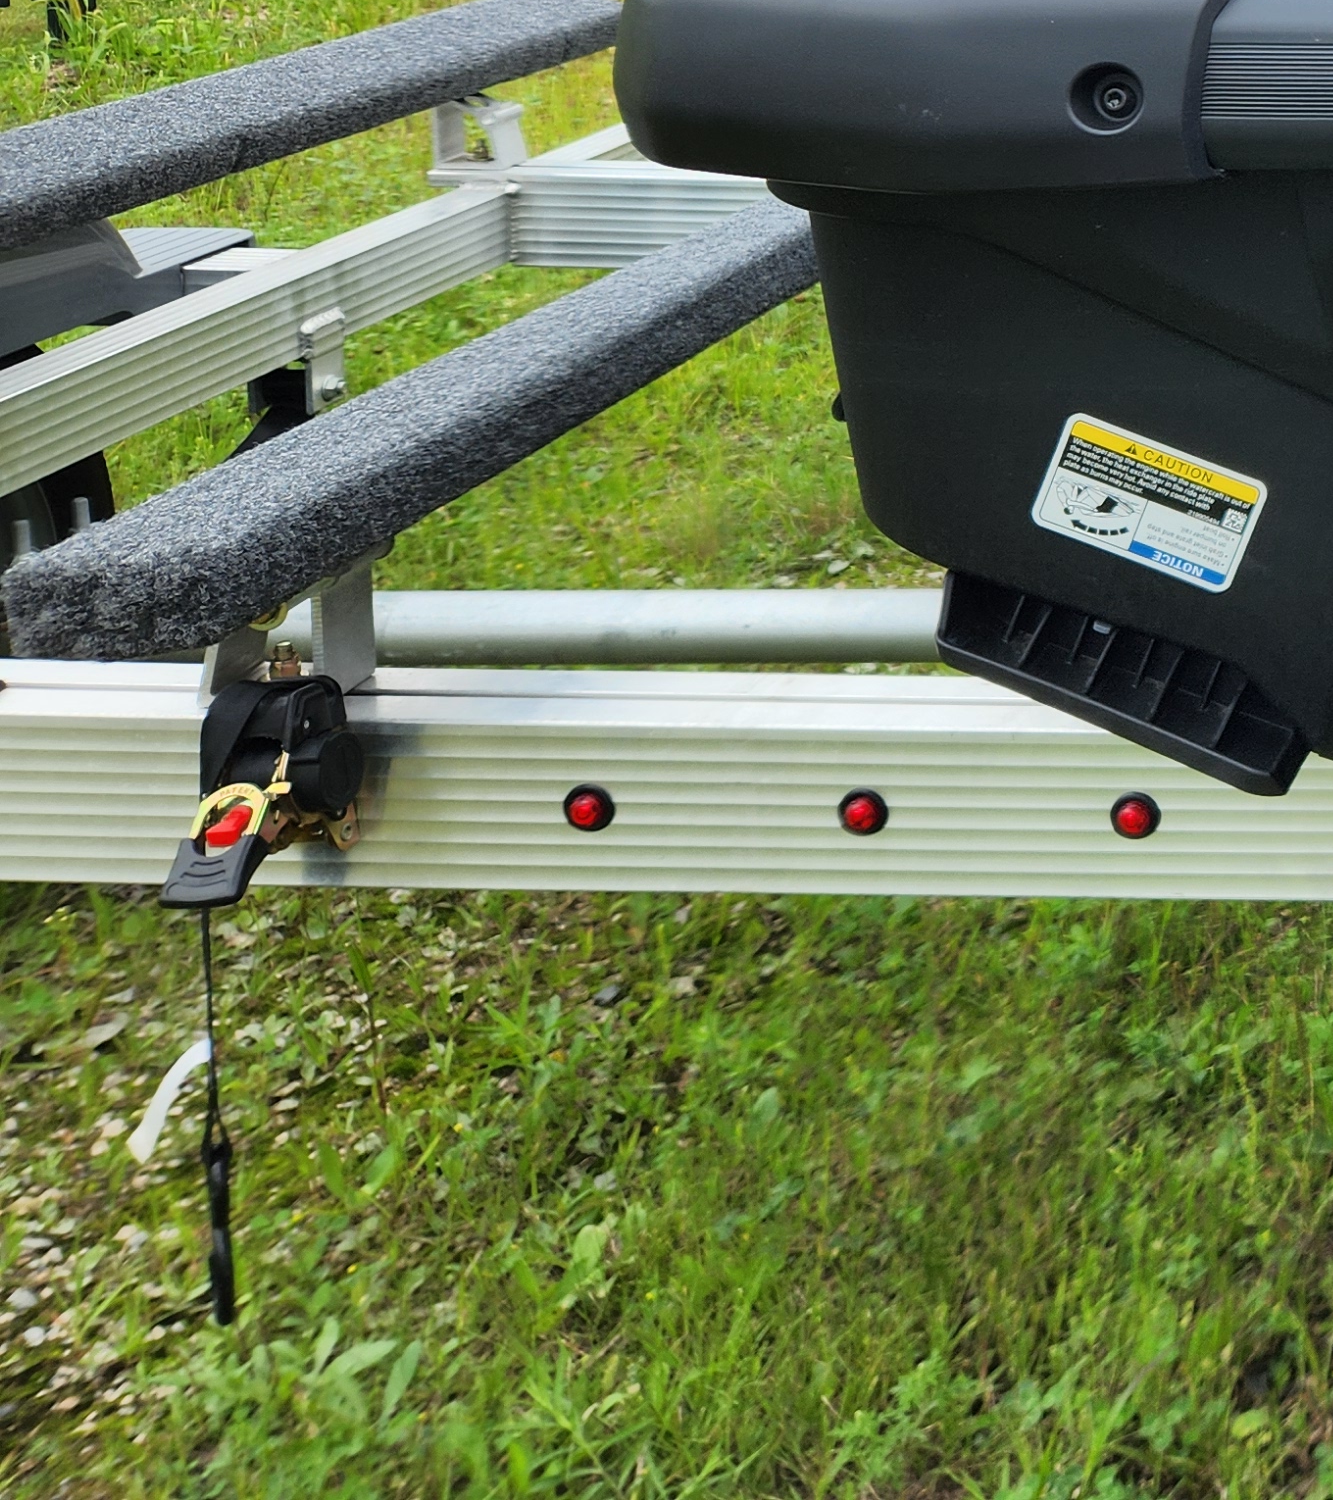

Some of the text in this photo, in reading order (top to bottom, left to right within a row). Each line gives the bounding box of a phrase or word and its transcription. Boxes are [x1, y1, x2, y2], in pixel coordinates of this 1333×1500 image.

[1073, 438, 1092, 449] When
[1093, 446, 1124, 462] operating
[1124, 458, 1136, 466] the
[1136, 463, 1158, 475] engine
[1178, 478, 1189, 486] the
[1144, 450, 1214, 484] CAUTION
[1114, 462, 1129, 472] heat
[1129, 468, 1164, 486] exchanger
[1198, 493, 1215, 505] plate
[1152, 550, 1204, 577] NOTICE
